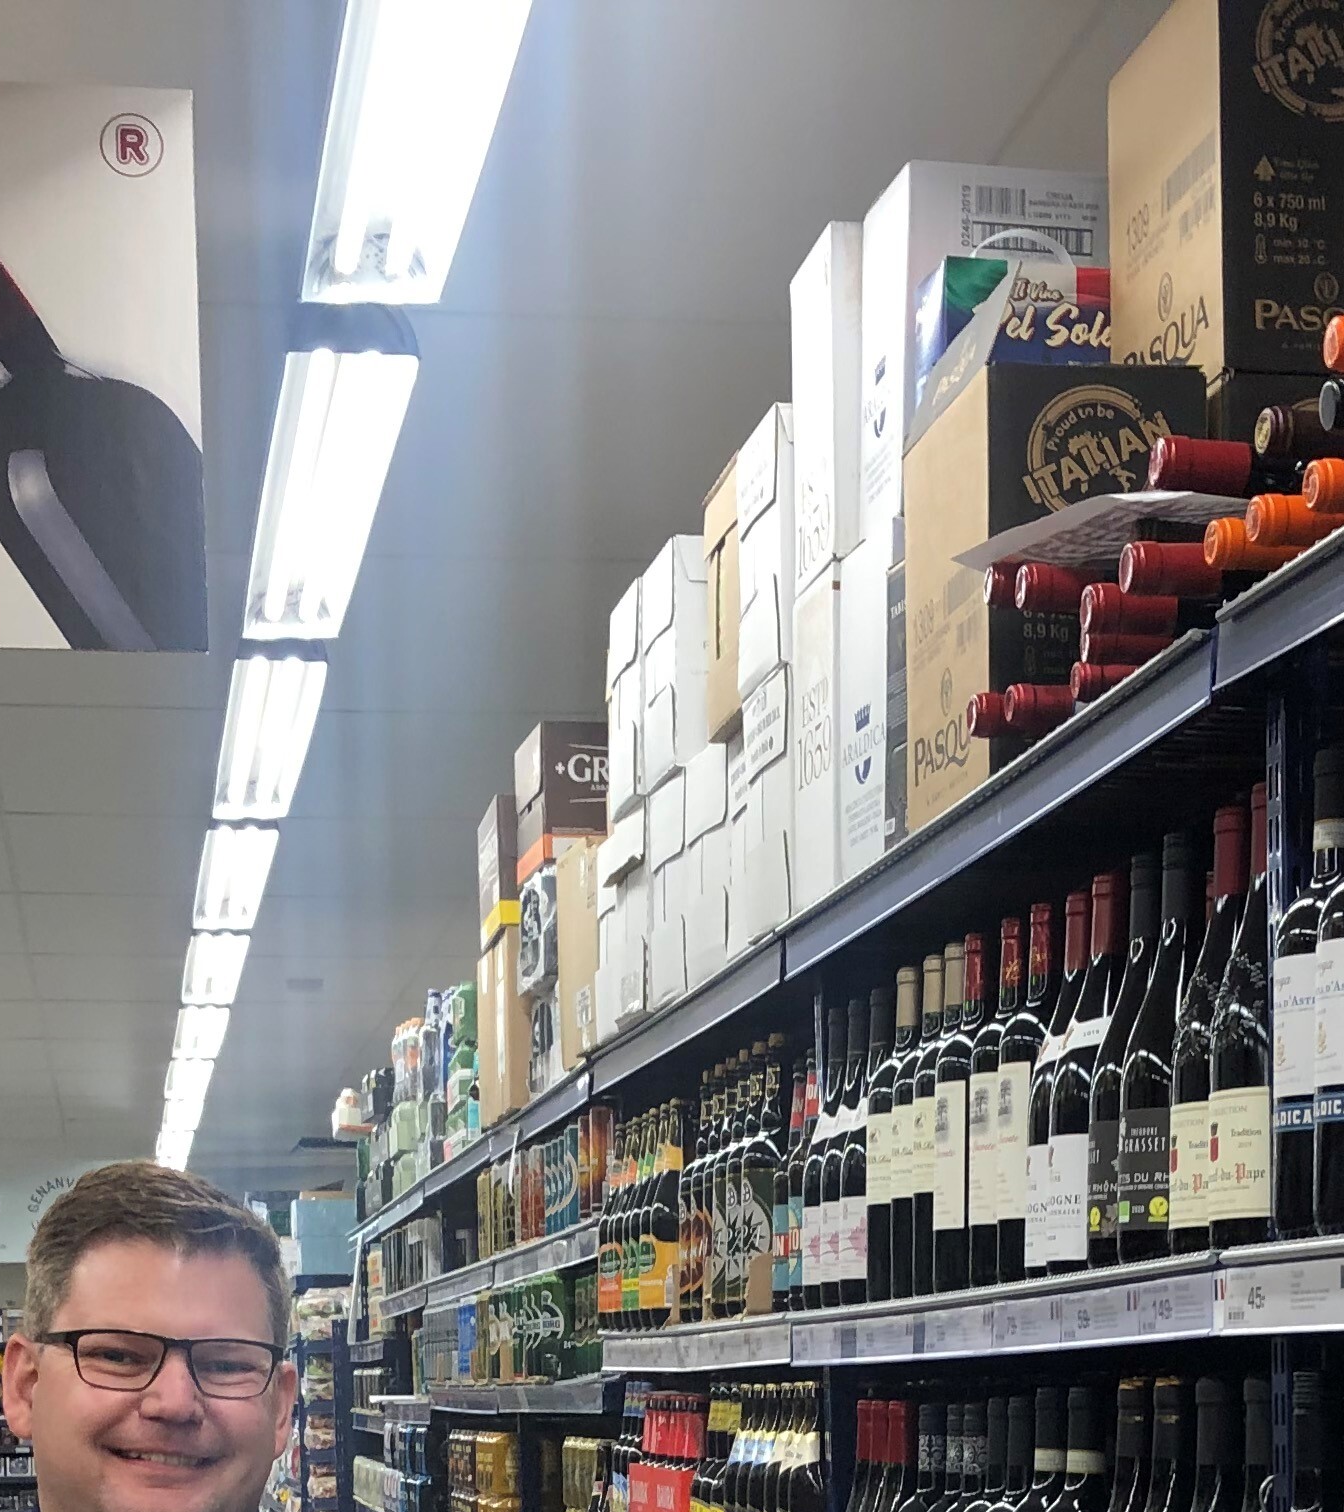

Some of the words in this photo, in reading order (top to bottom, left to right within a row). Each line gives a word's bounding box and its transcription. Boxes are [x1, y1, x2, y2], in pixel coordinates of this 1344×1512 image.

[1279, 193, 1305, 210] 750
[1308, 196, 1326, 211] ml
[1279, 213, 1298, 232] Kg
[1046, 409, 1079, 451] Proud
[1022, 411, 1172, 504] ITALIAN
